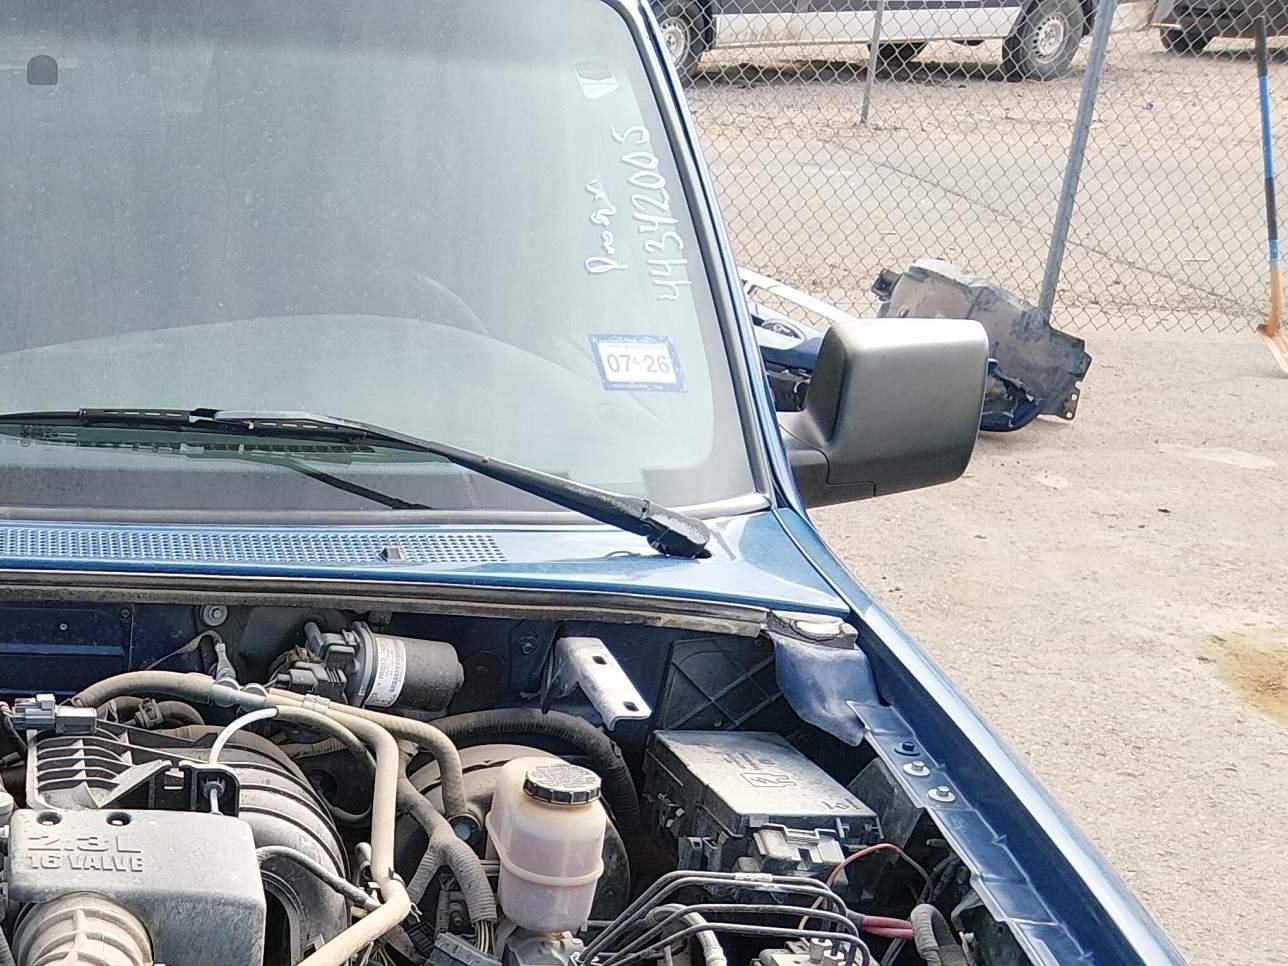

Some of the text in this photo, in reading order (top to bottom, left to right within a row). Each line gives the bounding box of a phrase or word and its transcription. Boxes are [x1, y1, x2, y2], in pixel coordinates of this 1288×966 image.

[611, 126, 692, 301] 44342005
[606, 353, 670, 375] 07 26
[27, 834, 142, 855] 2.3L
[27, 854, 145, 873] 16 VALVE
